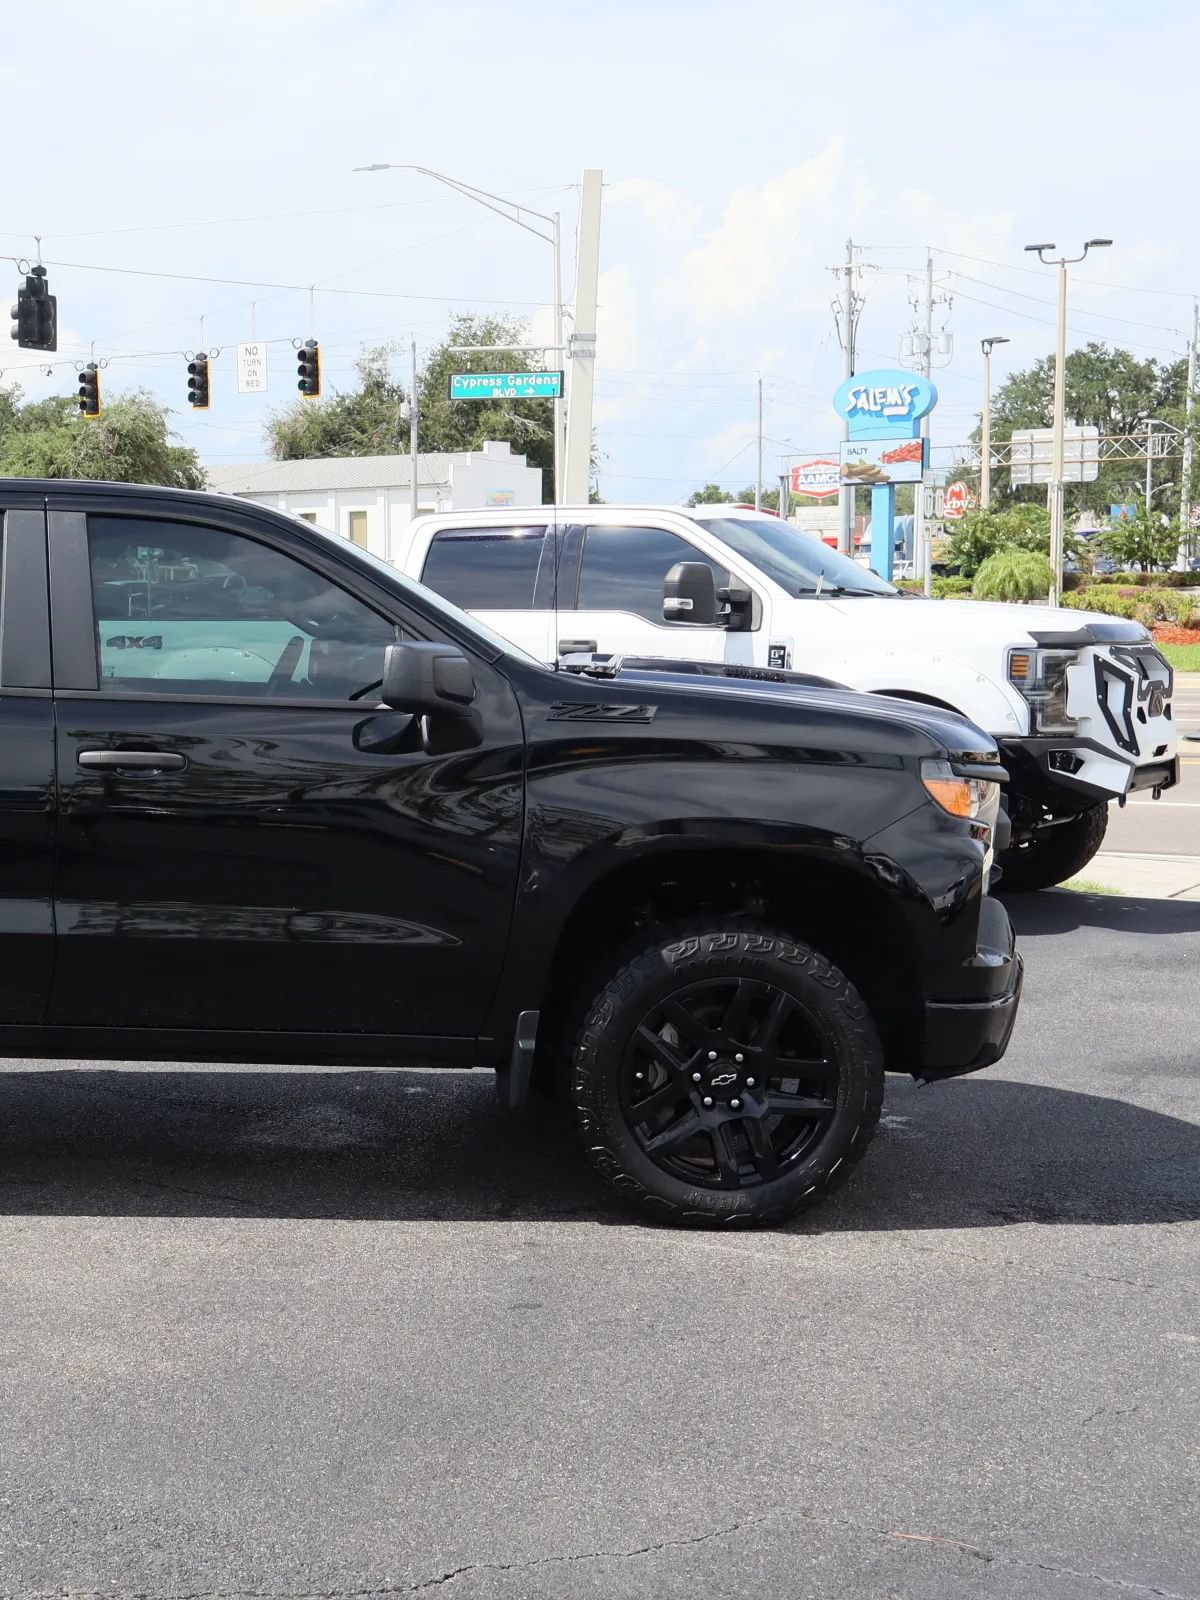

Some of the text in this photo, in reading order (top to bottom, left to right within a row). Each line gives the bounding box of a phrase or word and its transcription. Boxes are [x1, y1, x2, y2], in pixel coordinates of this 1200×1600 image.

[245, 346, 259, 357] NO
[242, 359, 262, 367] TURN
[247, 369, 258, 377] ON
[246, 379, 260, 388] RED
[453, 374, 558, 390] Cypress Gardens
[492, 388, 517, 397] BLVD
[845, 384, 917, 412] SALEM'S
[847, 447, 868, 456] SALTY
[943, 496, 976, 511] rby's
